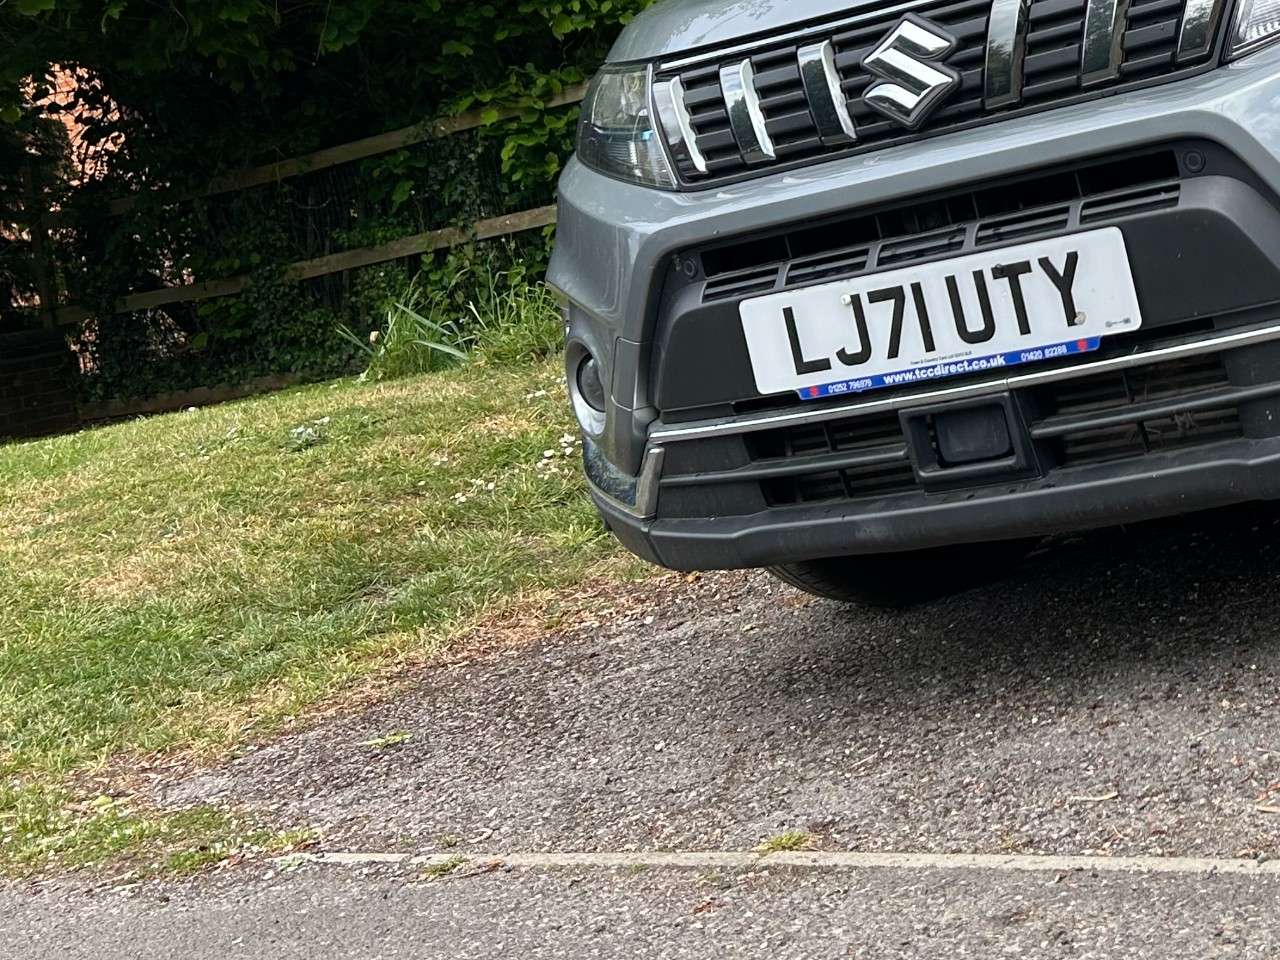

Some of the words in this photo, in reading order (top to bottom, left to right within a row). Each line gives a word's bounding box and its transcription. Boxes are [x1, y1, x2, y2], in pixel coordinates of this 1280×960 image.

[783, 282, 936, 375] LJ71
[945, 251, 1078, 344] UTY
[883, 355, 1006, 384] www.tccdirect.co.uk
